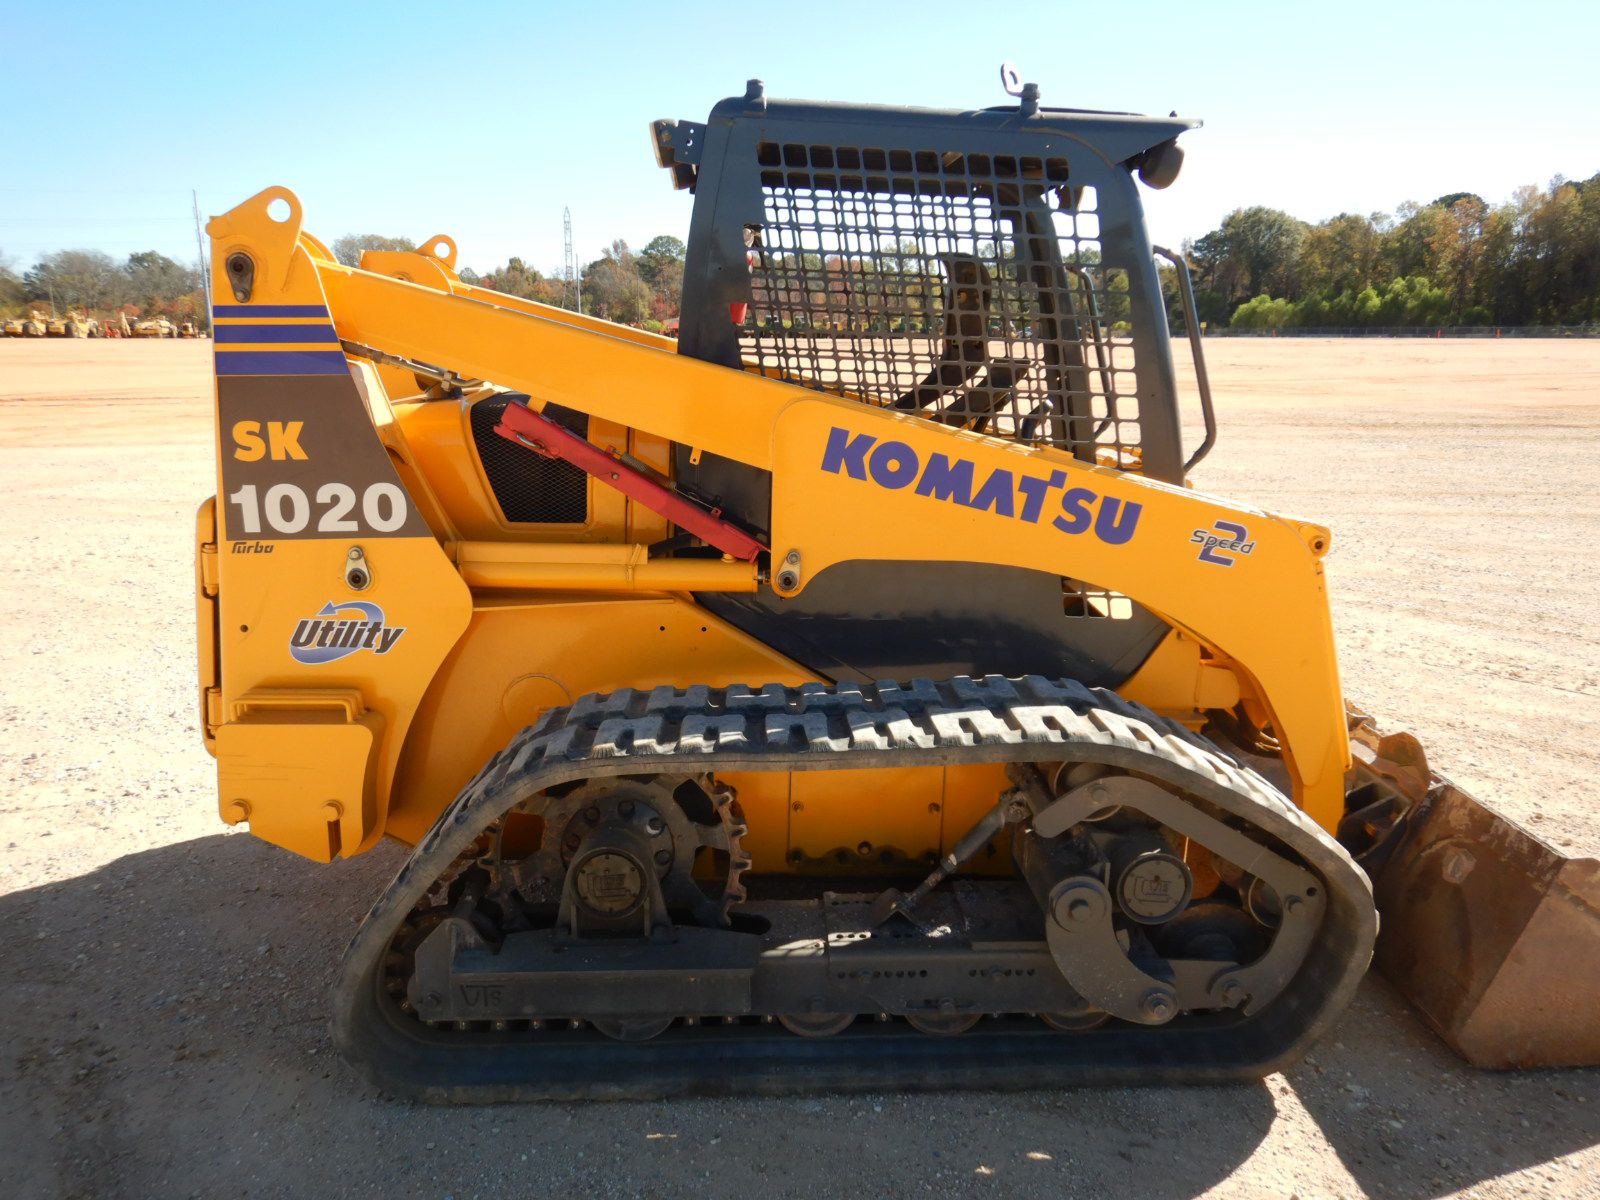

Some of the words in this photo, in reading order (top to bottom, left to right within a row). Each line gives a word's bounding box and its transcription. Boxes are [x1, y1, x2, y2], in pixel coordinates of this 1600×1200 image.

[231, 420, 309, 462] SK
[820, 426, 1143, 545] KOMATSU
[230, 482, 407, 534] 1020
[231, 541, 275, 554] Turbo
[1198, 520, 1248, 567] 2
[290, 618, 406, 655] Utility
